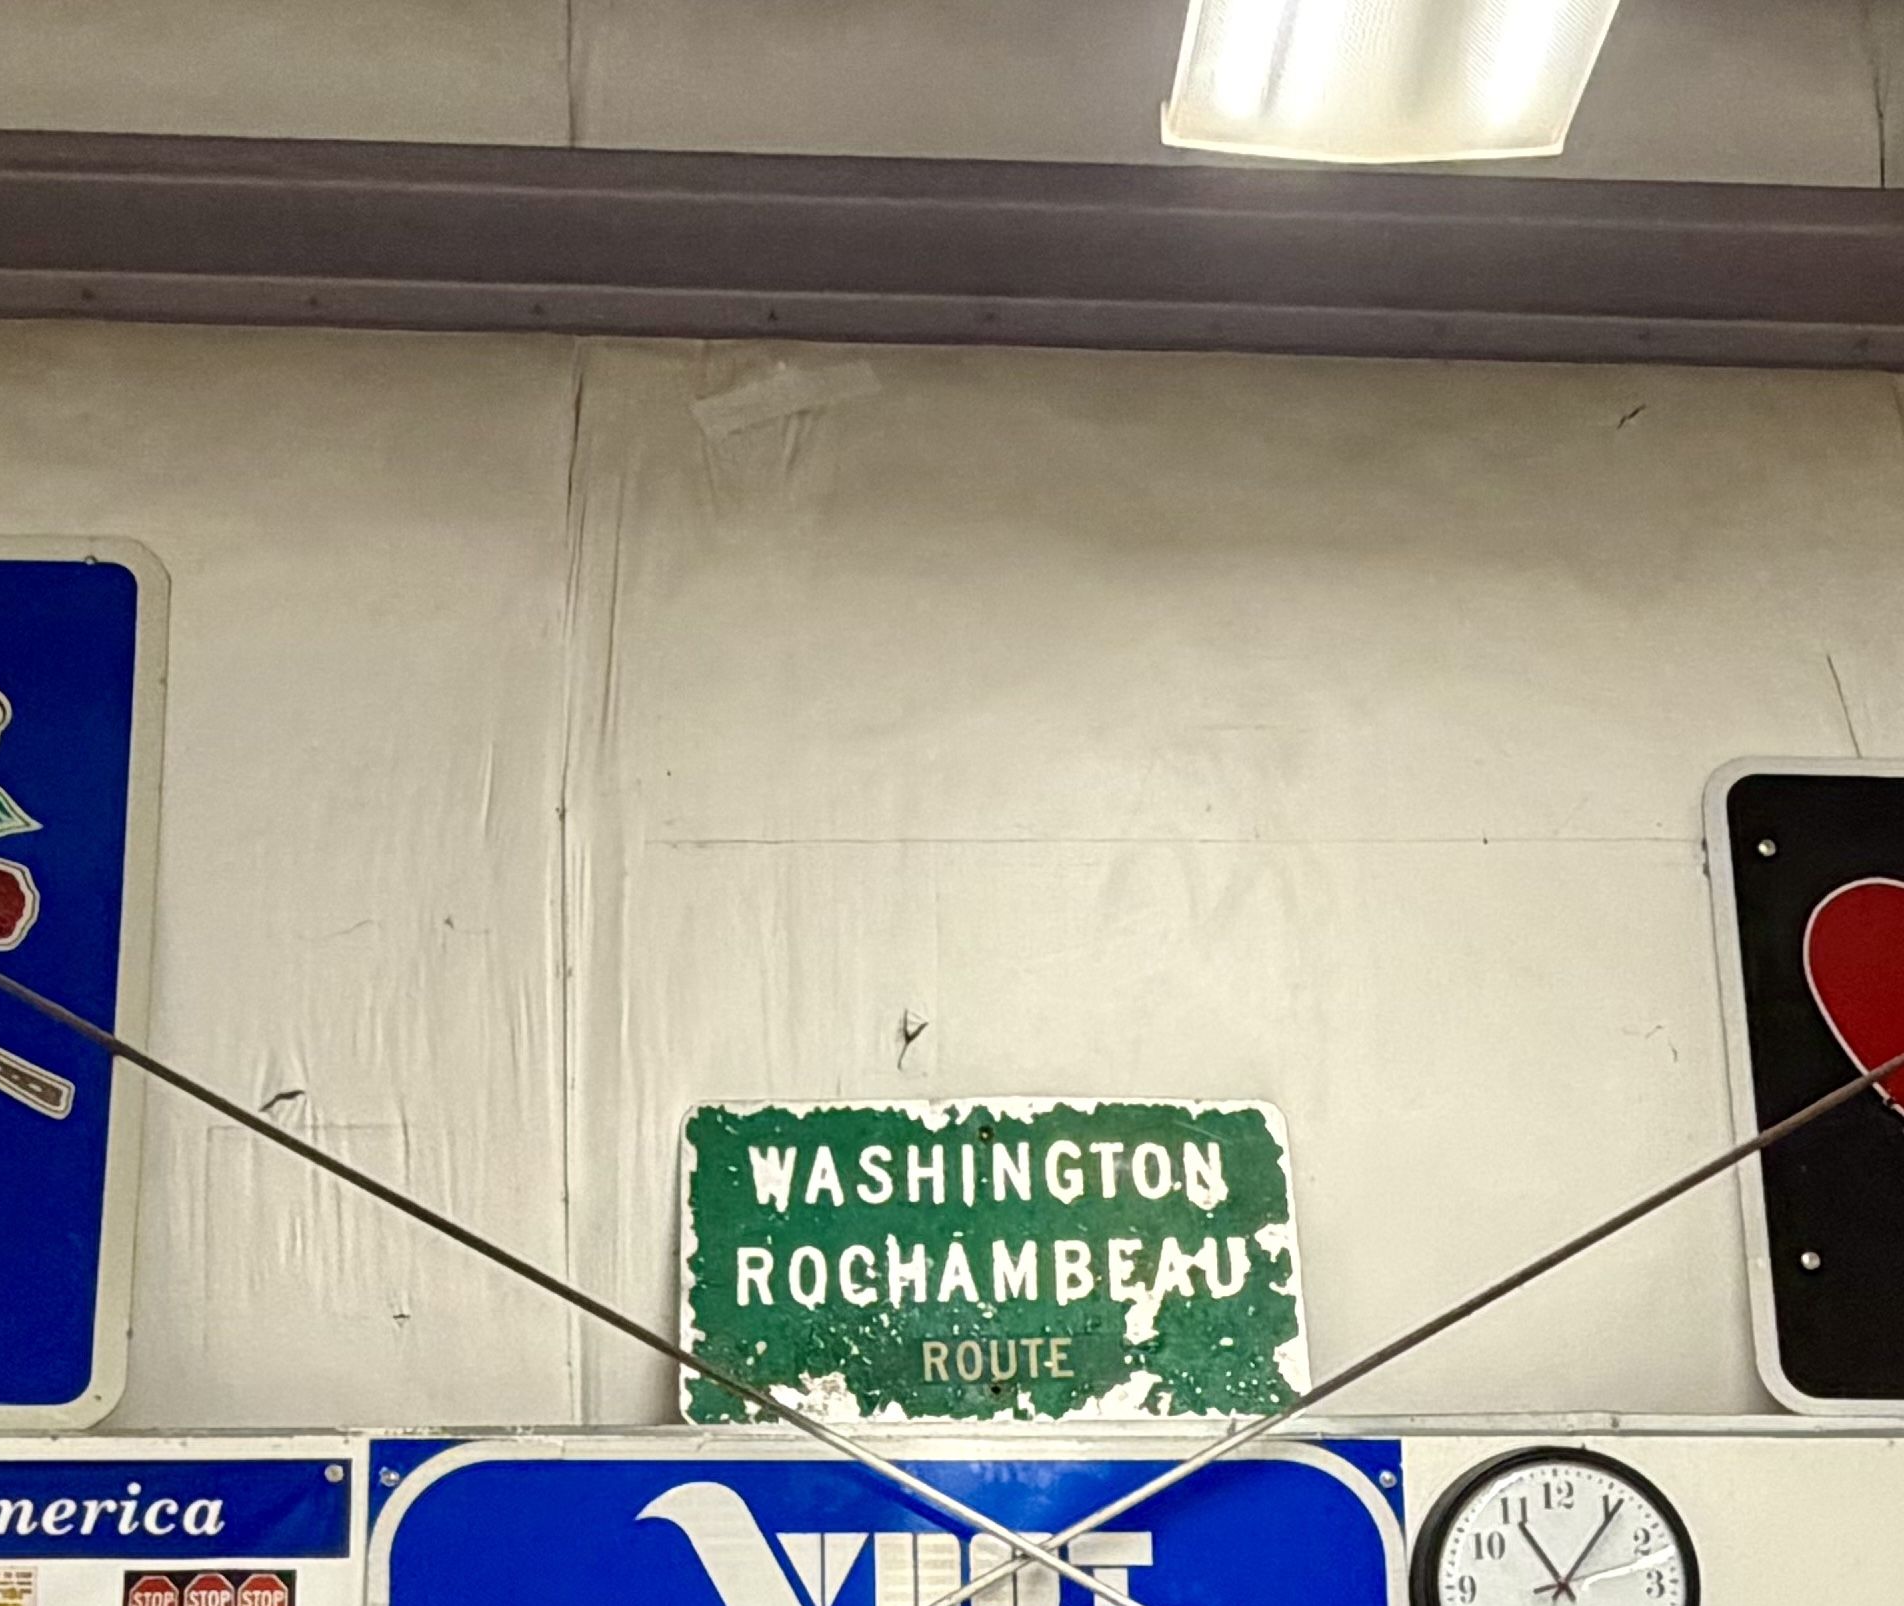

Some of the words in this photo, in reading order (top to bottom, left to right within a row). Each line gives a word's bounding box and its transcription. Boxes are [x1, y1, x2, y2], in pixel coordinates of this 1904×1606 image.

[748, 1140, 1228, 1210] WASHINGTON
[737, 1236, 1250, 1307] ROCHAMBEAU
[922, 1337, 1075, 1382] ROUTE
[1543, 1481, 1574, 1510] 12
[1500, 1497, 1528, 1524] 11
[1472, 1531, 1506, 1560] 10
[1633, 1528, 1650, 1556] 2
[1458, 1575, 1477, 1604] 9
[1646, 1569, 1665, 1598] 3
